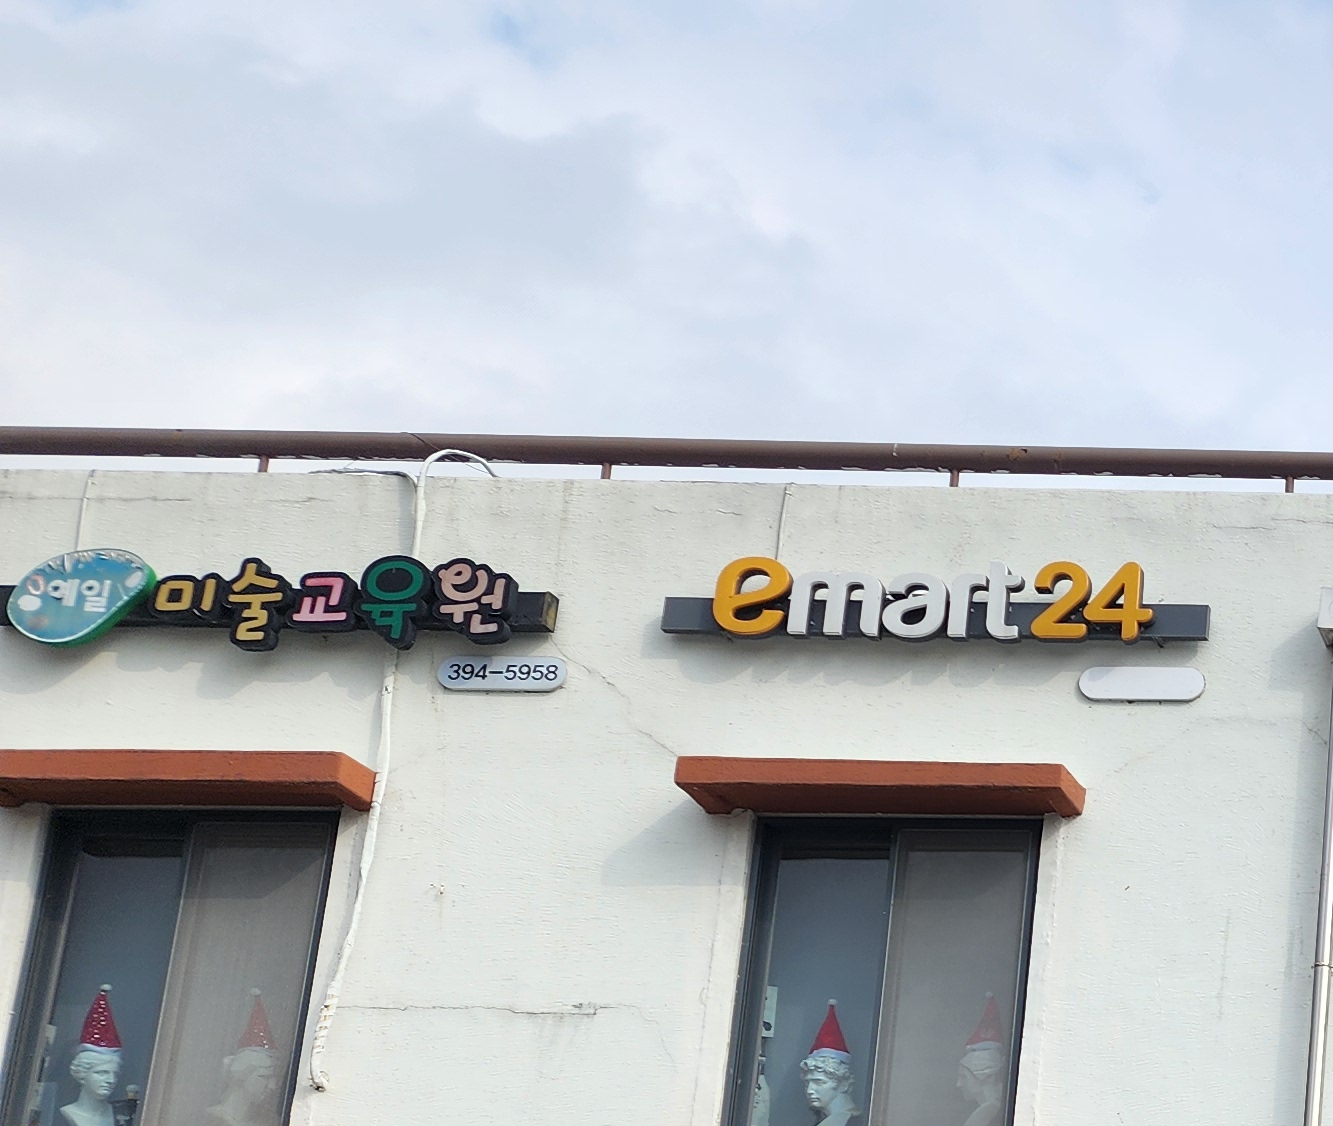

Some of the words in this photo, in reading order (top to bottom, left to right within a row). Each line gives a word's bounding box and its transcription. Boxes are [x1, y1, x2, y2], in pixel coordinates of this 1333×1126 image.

[46, 578, 113, 613] 예일
[154, 557, 505, 643] 미술교육원
[711, 555, 1155, 643] emart24
[446, 662, 560, 683] 394-5958
